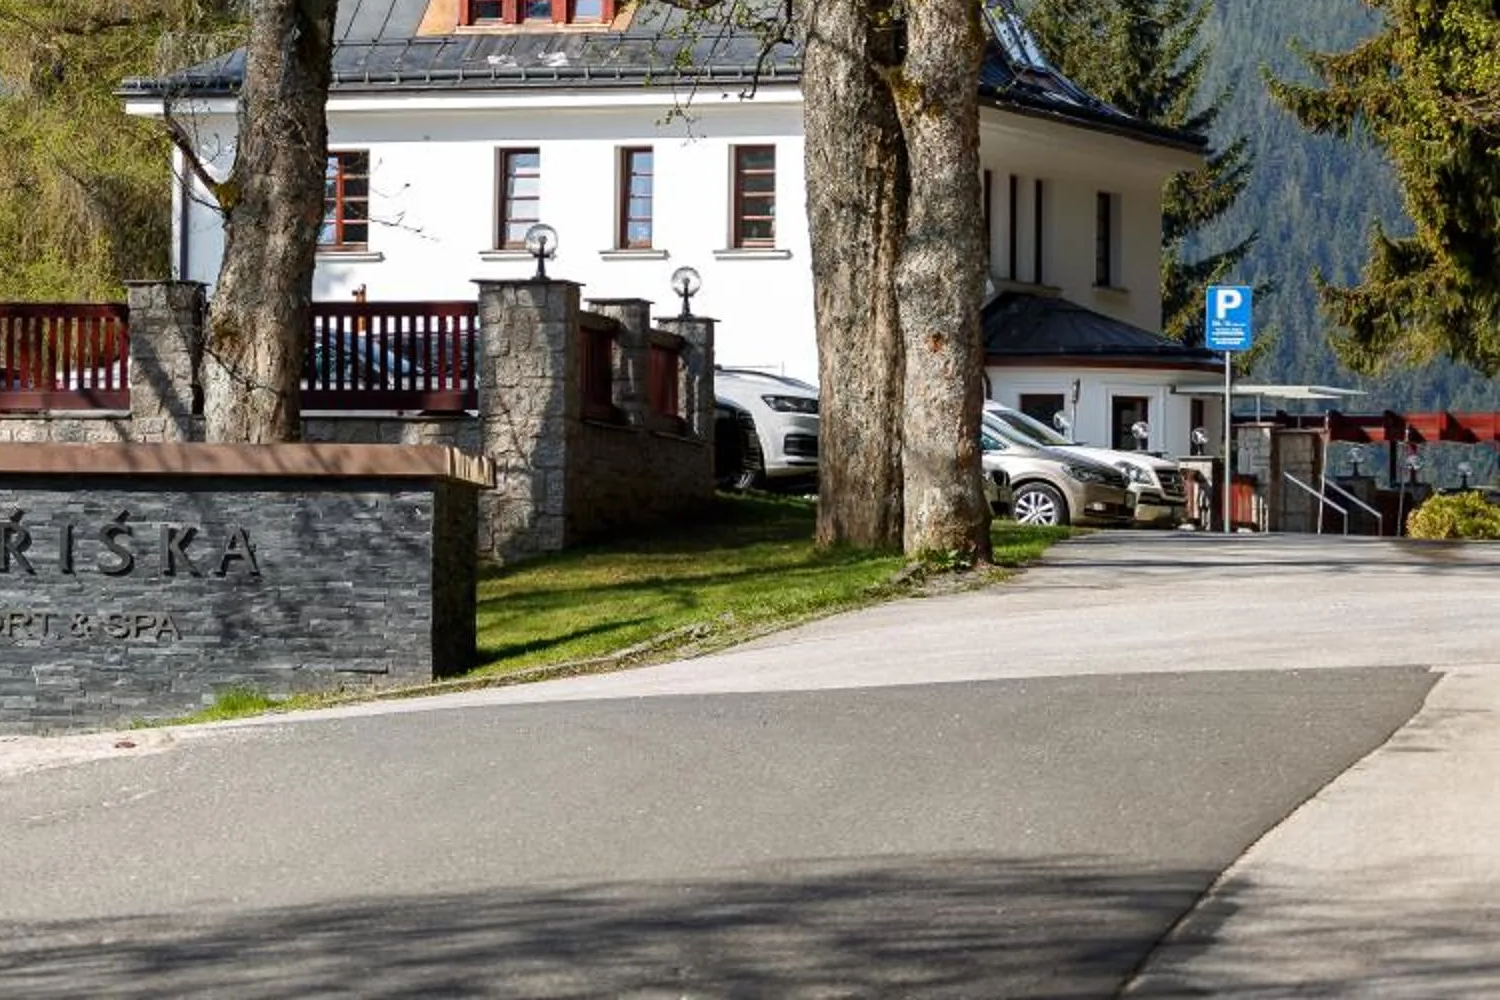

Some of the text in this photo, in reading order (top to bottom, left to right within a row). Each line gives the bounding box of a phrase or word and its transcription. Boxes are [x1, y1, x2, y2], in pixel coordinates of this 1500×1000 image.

[1216, 289, 1242, 319] P
[70, 612, 94, 638] &
[103, 613, 184, 641] SPA
